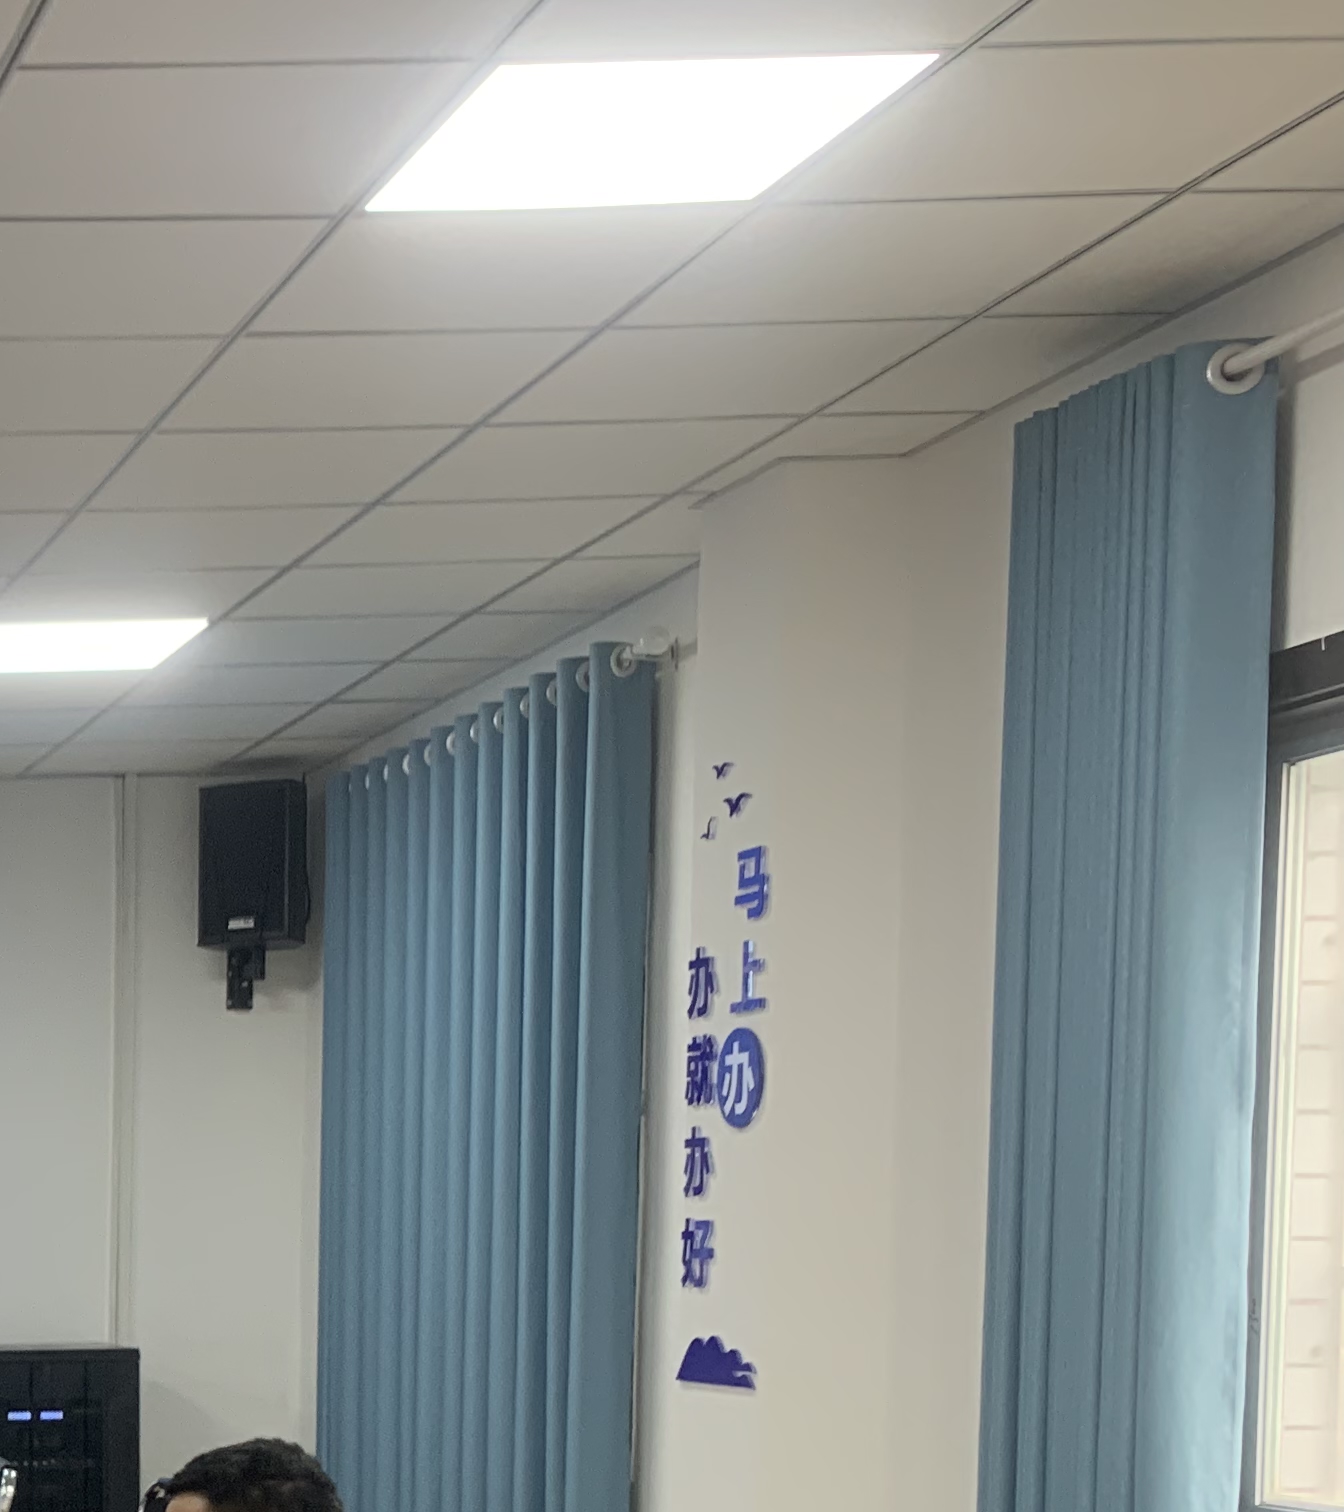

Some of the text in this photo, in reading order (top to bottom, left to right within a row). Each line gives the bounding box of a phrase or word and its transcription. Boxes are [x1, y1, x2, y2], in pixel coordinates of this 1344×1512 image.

[680, 945, 719, 1290] 办就办好
[719, 844, 770, 1120] 马上办
